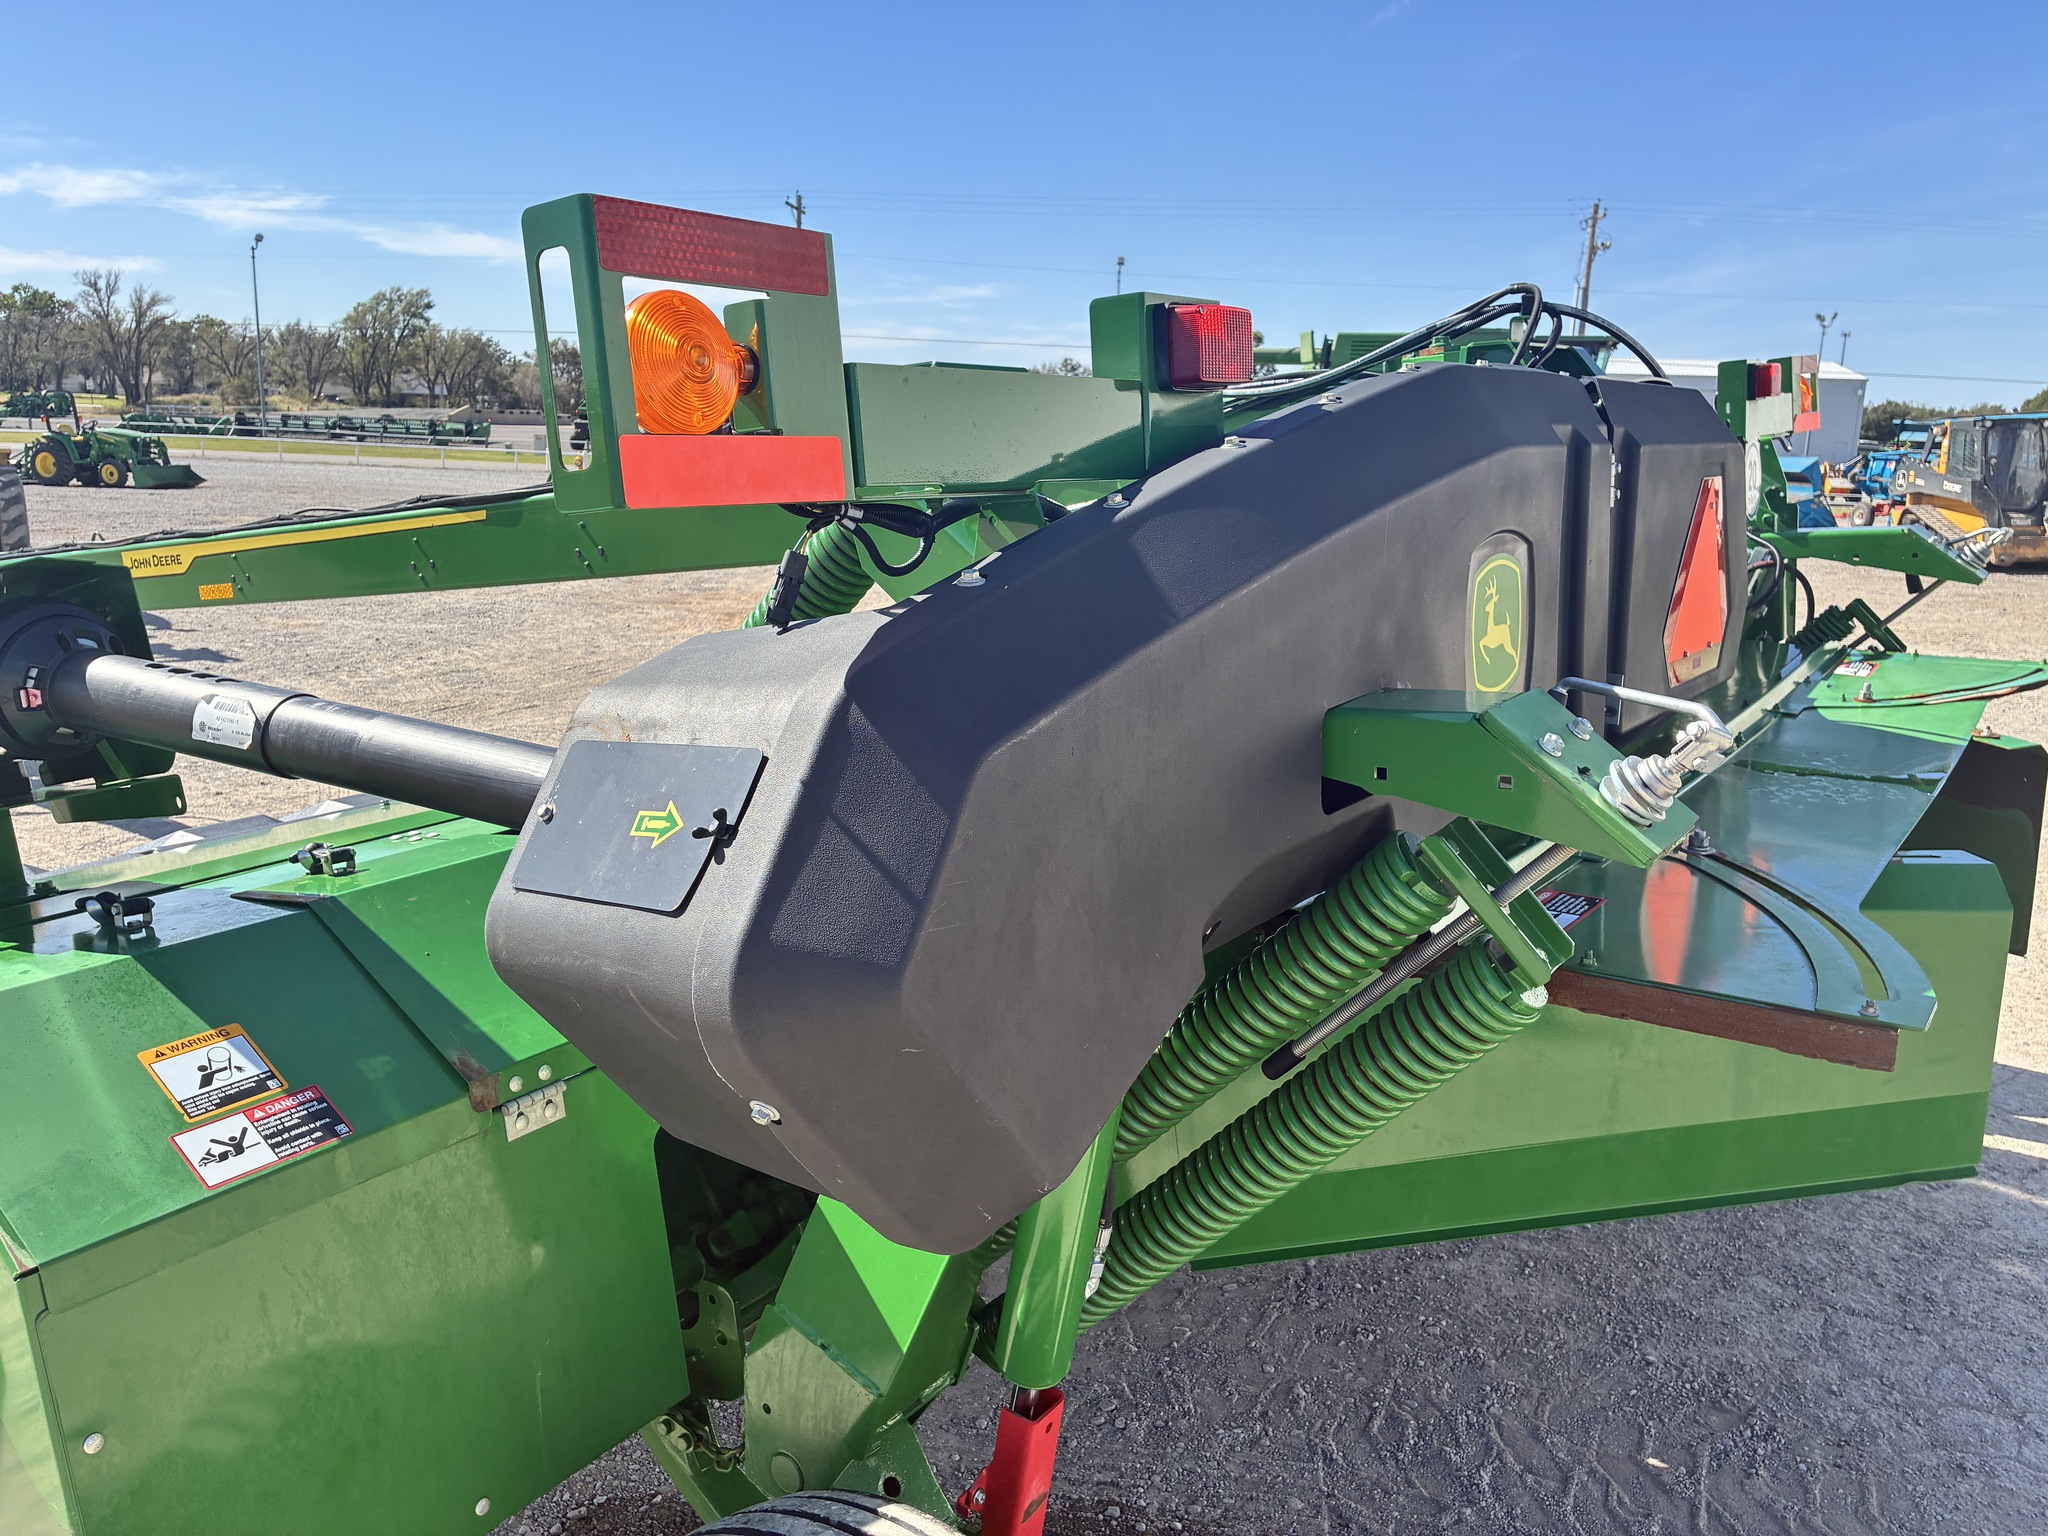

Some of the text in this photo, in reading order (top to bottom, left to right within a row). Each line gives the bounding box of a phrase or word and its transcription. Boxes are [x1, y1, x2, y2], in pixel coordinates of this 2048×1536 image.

[1943, 479, 1962, 493] DEERE
[130, 554, 182, 569] JOHN DEERE
[167, 1029, 230, 1053] WARNING
[265, 1092, 314, 1113] DANGER
[254, 1110, 291, 1126] Entanglement
[297, 1101, 318, 1111] rotating
[258, 1120, 281, 1131] driveline
[292, 1110, 307, 1118] cause
[308, 1103, 327, 1112] serious
[260, 1127, 277, 1136] injury
[284, 1119, 301, 1127] death.
[267, 1136, 282, 1144] Keep
[290, 1126, 309, 1136] shields
[315, 1118, 331, 1127] place.
[275, 1144, 290, 1153] Avoid
[291, 1136, 311, 1146] contact
[278, 1141, 315, 1157] rotating parts.
